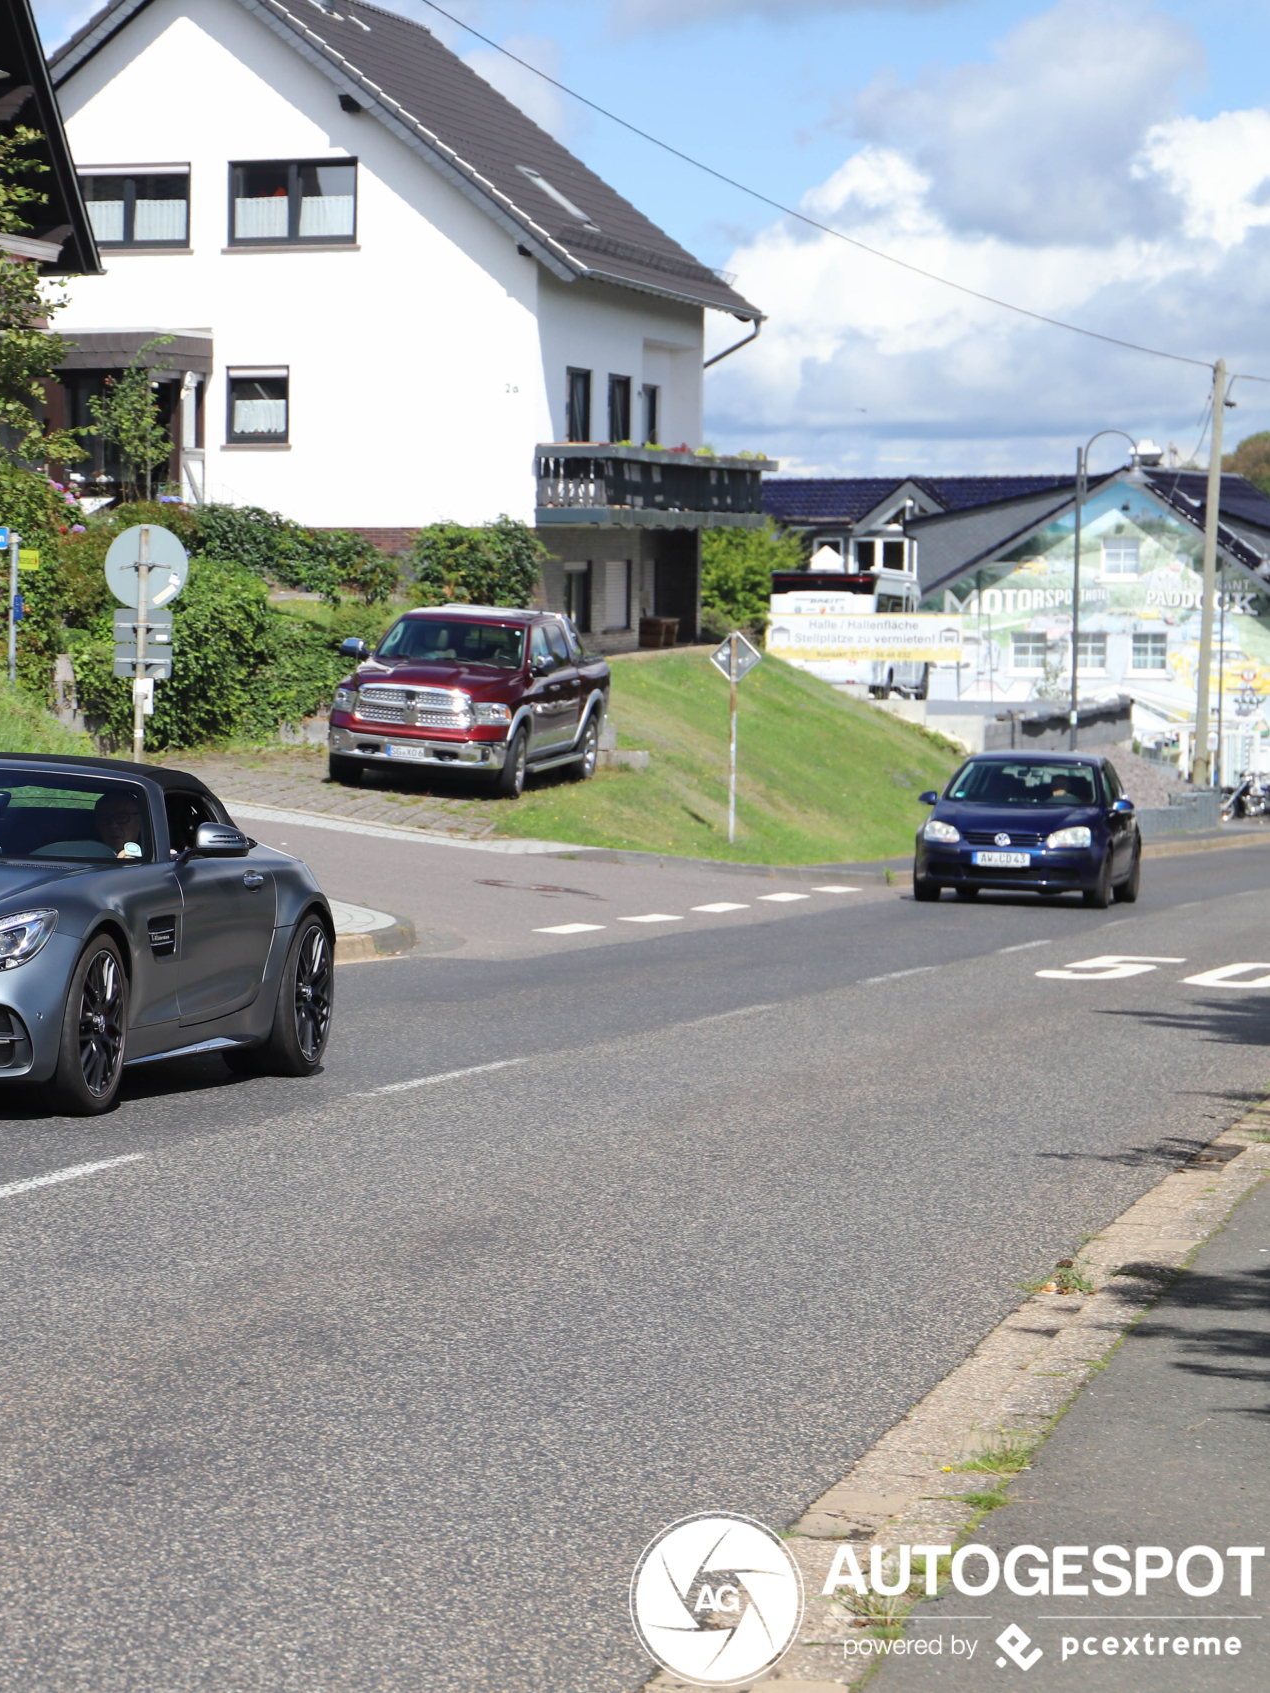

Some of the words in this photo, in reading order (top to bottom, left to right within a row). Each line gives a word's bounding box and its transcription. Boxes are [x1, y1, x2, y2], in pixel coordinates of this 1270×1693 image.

[809, 620, 837, 630] Halle
[848, 620, 919, 631] Hallenfläche
[795, 633, 854, 644] Stellplätze
[857, 635, 870, 643] zu
[874, 634, 936, 644] vermieten!
[981, 853, 993, 863] AW
